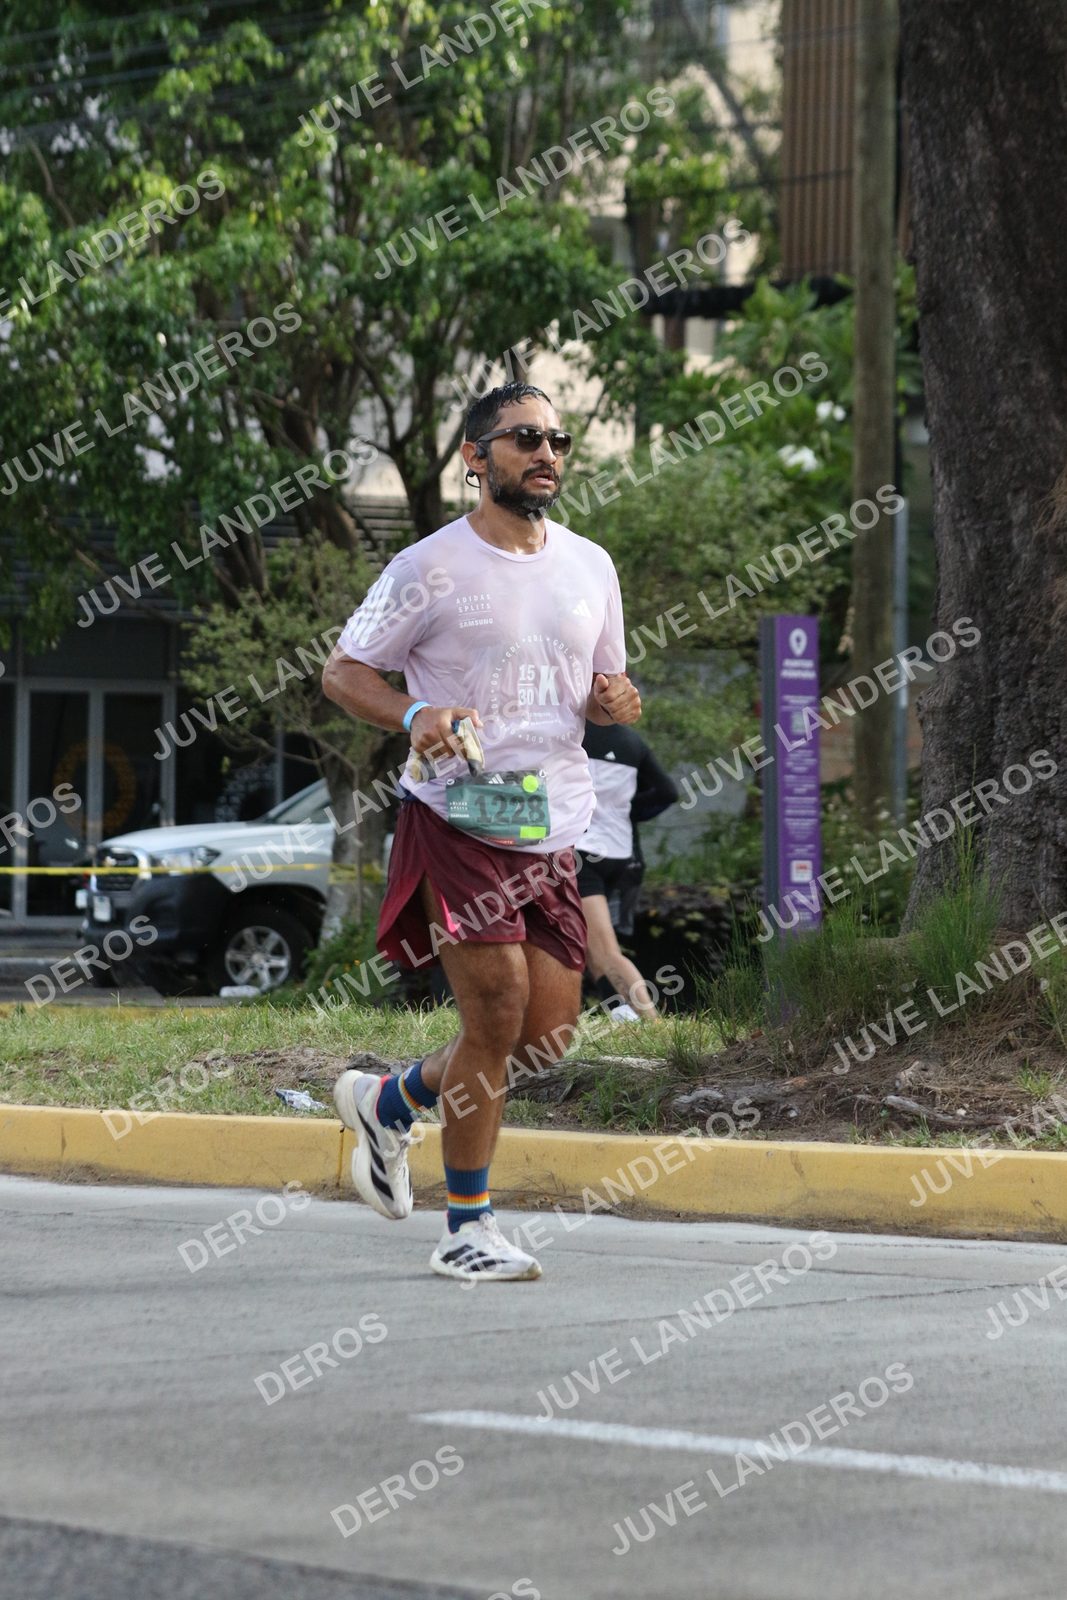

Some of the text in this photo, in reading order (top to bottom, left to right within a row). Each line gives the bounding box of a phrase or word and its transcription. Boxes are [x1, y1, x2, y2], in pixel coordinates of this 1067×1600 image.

[456, 594, 491, 604] ADIDAS
[458, 603, 491, 613] SPLITS
[459, 618, 494, 628] SAMSUNG
[519, 664, 536, 681] 15
[539, 664, 560, 706] K
[519, 688, 535, 706] 30
[474, 794, 546, 824] 1228
